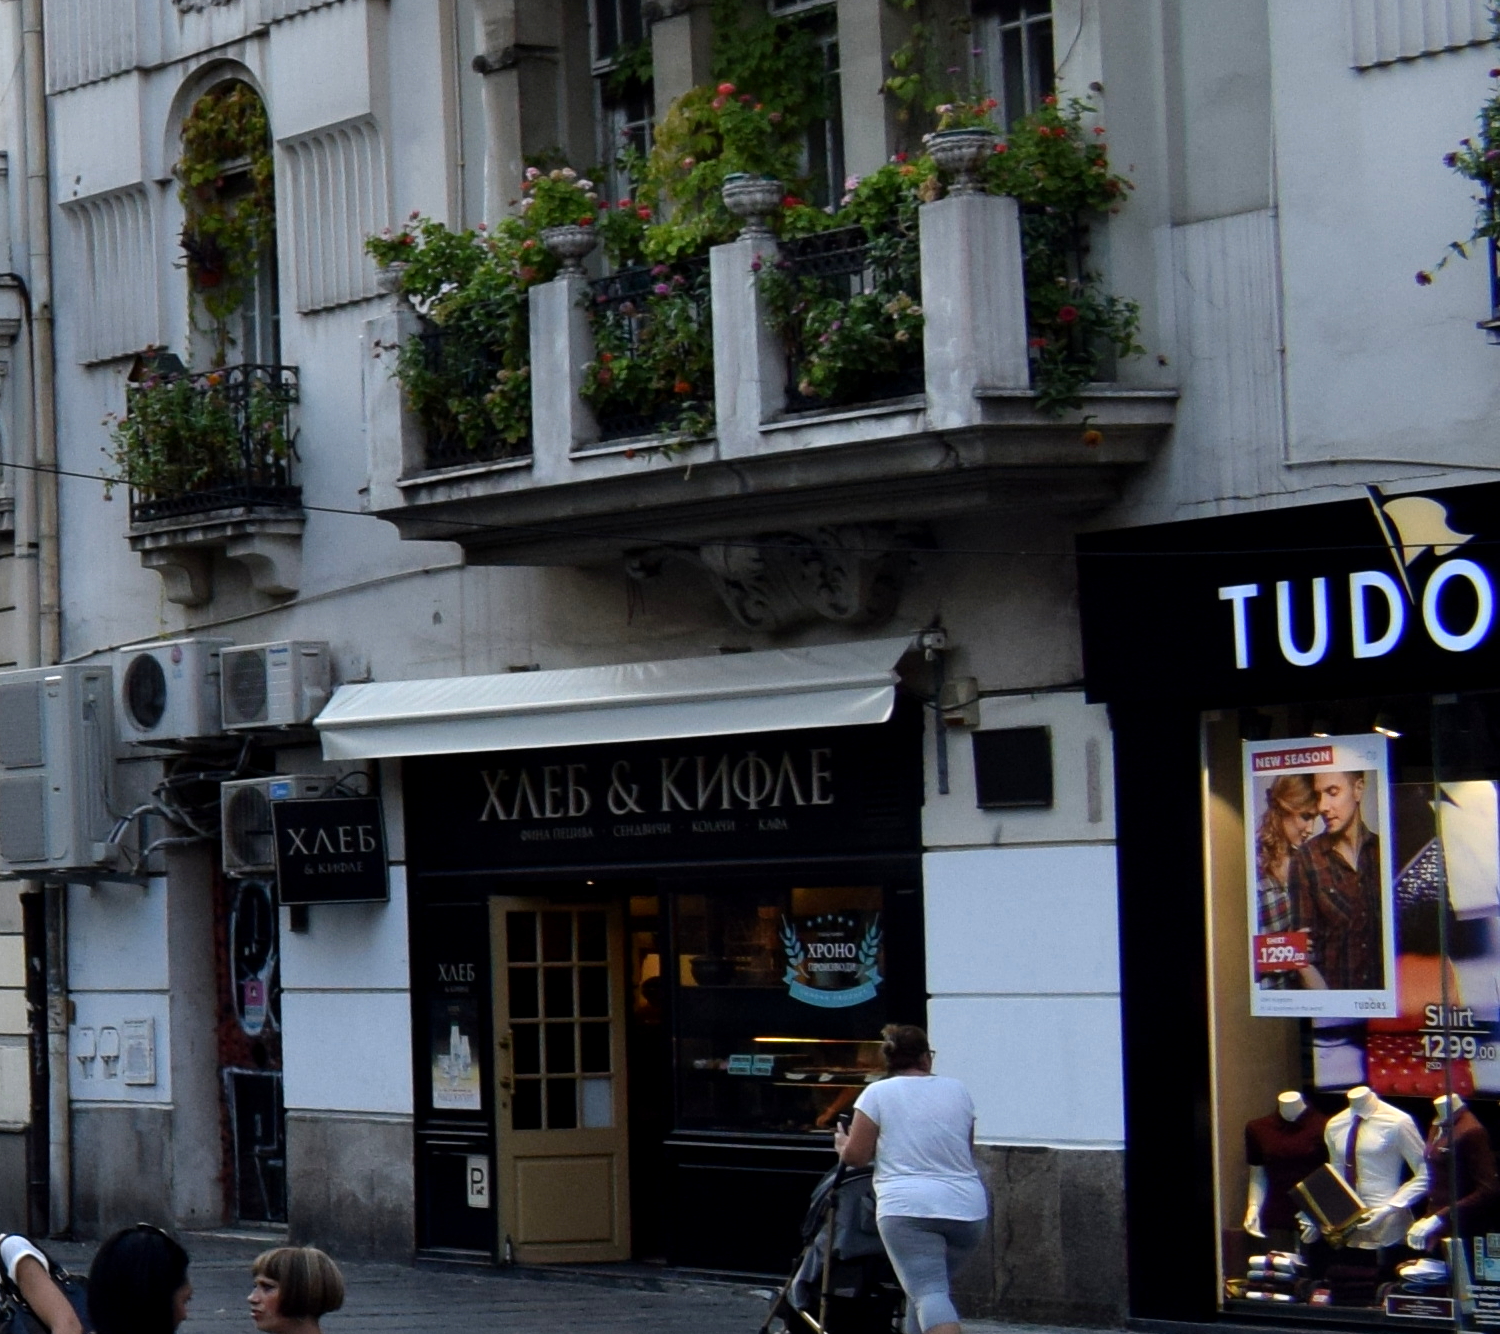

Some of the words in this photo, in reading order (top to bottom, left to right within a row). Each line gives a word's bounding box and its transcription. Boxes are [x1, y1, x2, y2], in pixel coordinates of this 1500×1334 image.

[1218, 559, 1494, 670] TUDO
[1255, 755, 1281, 768] NEW
[1284, 750, 1331, 766] SEASON
[479, 764, 591, 821] ХЛЕБ
[607, 760, 647, 815] &
[658, 747, 835, 812] КИФЛЕ
[286, 825, 376, 856] ХЛЕБ
[318, 861, 364, 874] КИФЛЕ
[807, 943, 857, 958] ХРОНО
[438, 963, 476, 982] ХЛЕБ
[1354, 1001, 1387, 1010] TUDORS
[1425, 1005, 1475, 1027] Shirt
